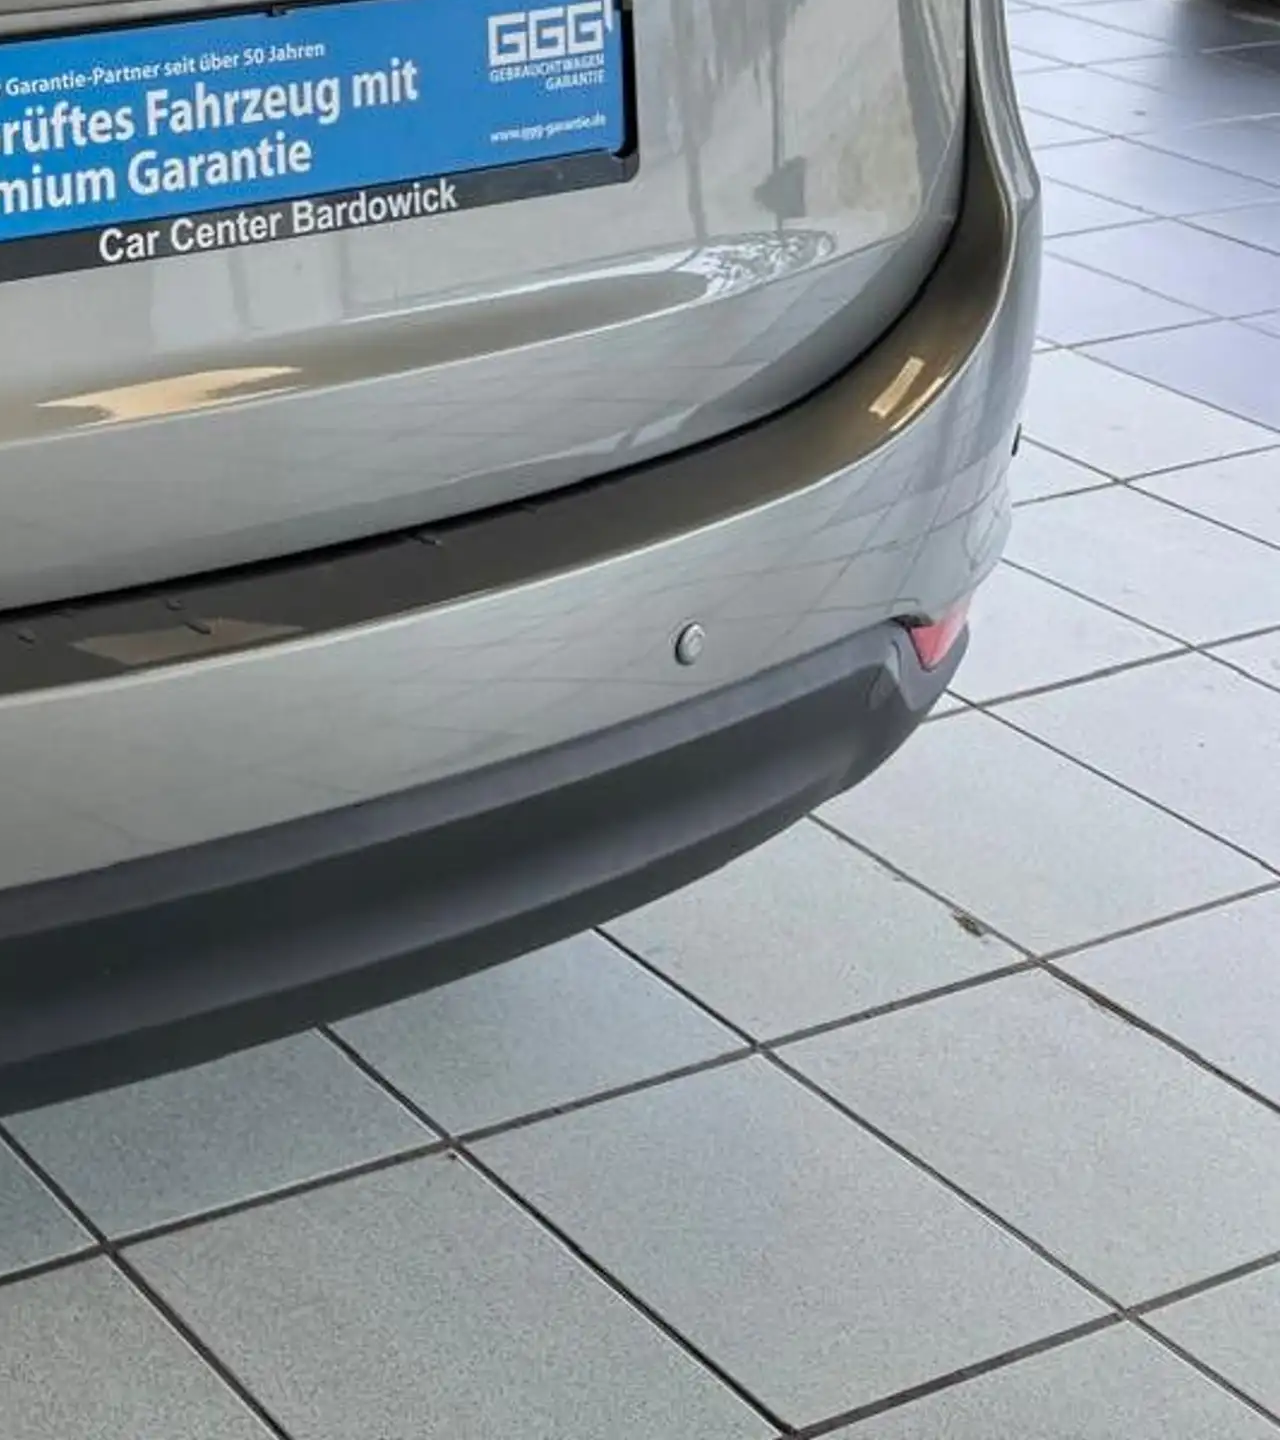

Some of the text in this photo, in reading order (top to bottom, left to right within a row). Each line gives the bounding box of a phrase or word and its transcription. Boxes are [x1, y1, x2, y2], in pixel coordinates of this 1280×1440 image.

[488, 0, 606, 67] GGG
[5, 62, 159, 97] Garantie-Partner
[164, 56, 196, 77] seit
[200, 50, 239, 72] über
[243, 47, 264, 66] 50
[267, 42, 325, 63] Jahren
[145, 76, 340, 137] Fahrzeug
[352, 57, 419, 108] mit
[490, 53, 605, 83] GEBRAUCHTWAGEN
[545, 68, 606, 90] GARANTIE
[128, 130, 313, 196] Garantie
[99, 177, 458, 262] Car Center Bardowick
